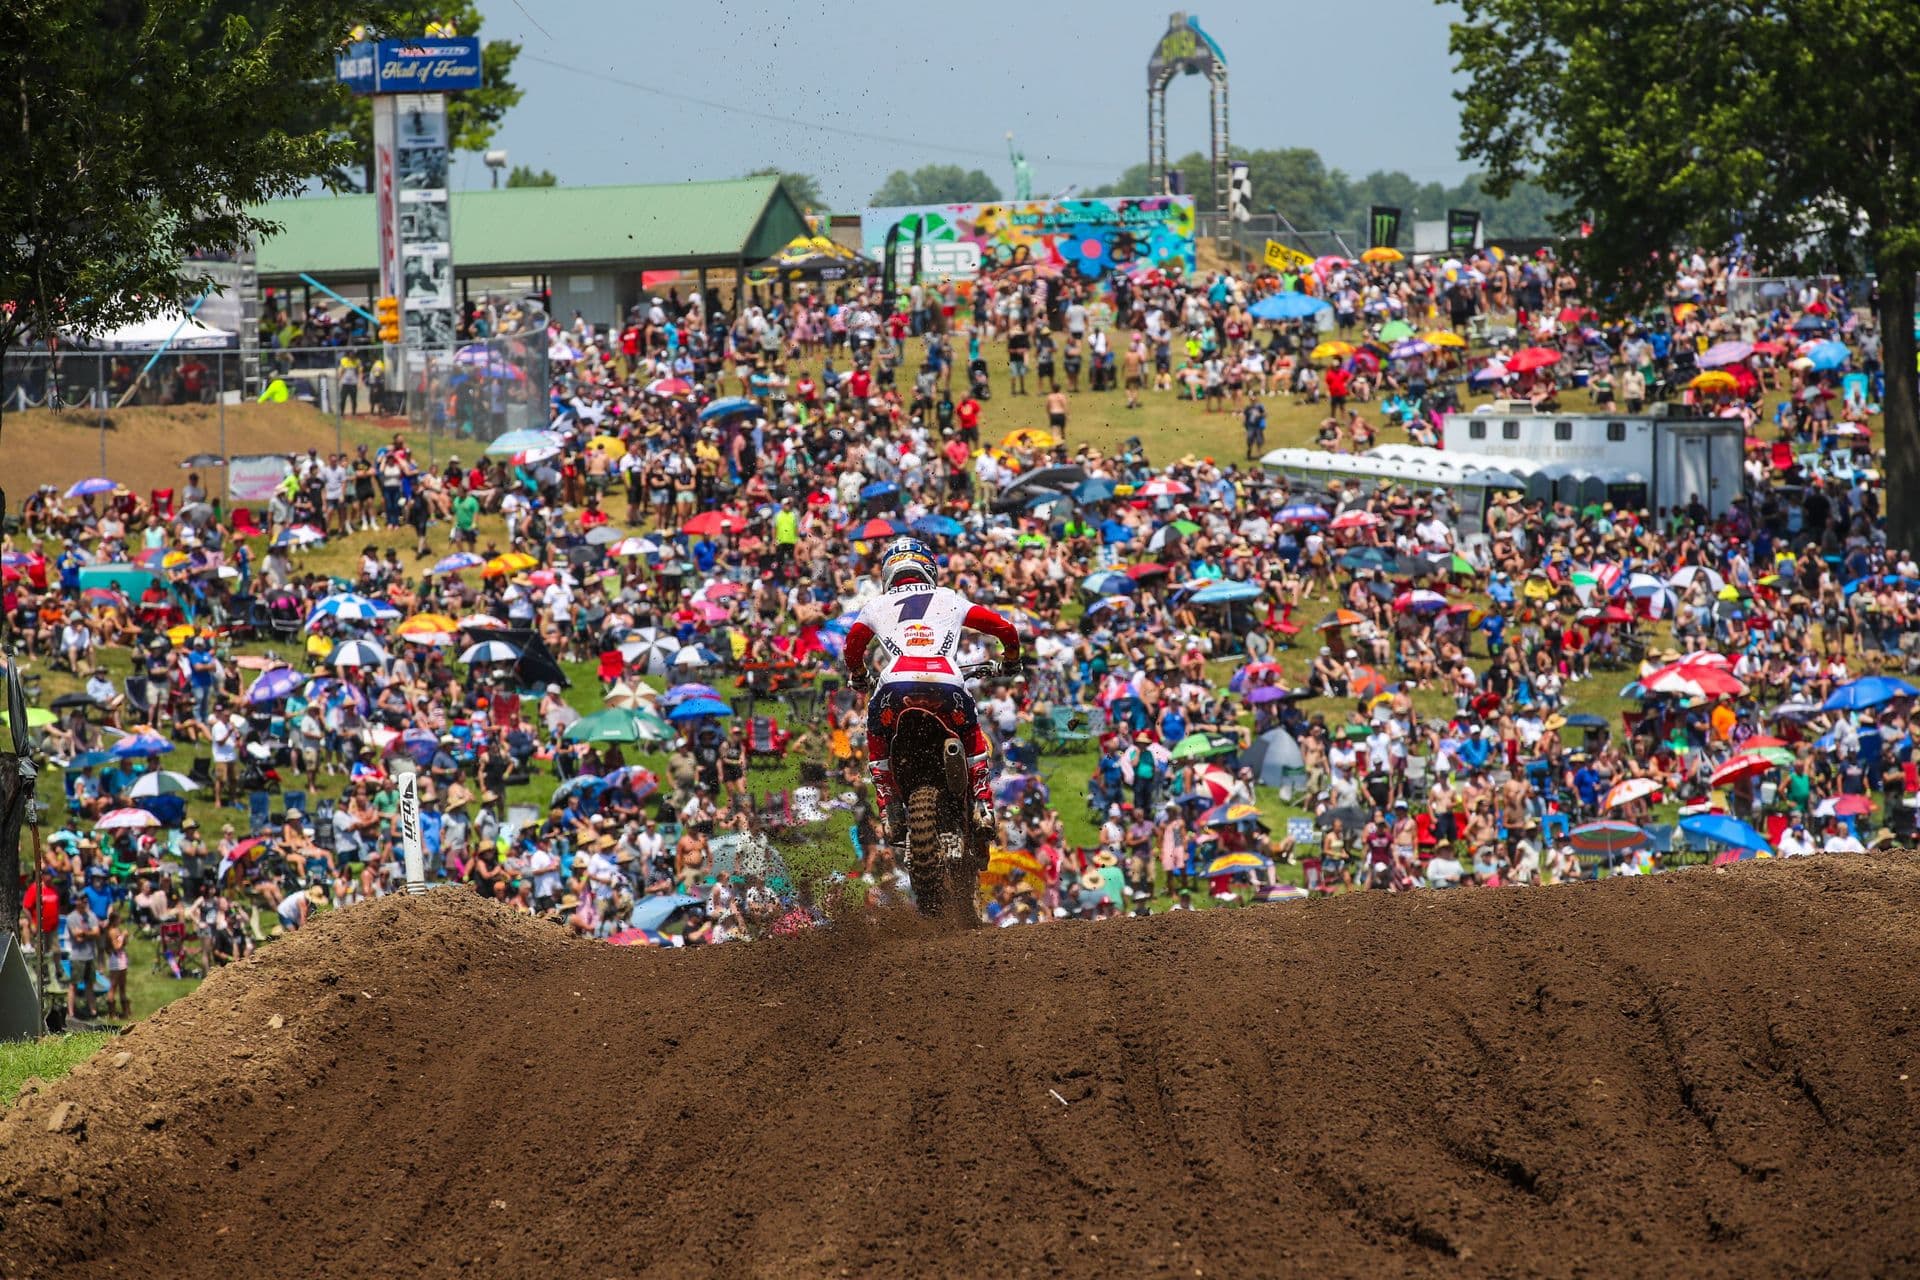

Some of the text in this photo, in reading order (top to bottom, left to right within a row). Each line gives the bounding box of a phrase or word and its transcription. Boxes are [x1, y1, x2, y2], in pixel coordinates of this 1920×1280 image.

[381, 61, 417, 79] Hall
[416, 61, 434, 83] of
[433, 60, 477, 78] Fame
[888, 584, 936, 595] SEXTON
[894, 593, 934, 623] 1
[402, 800, 414, 840] UFO
